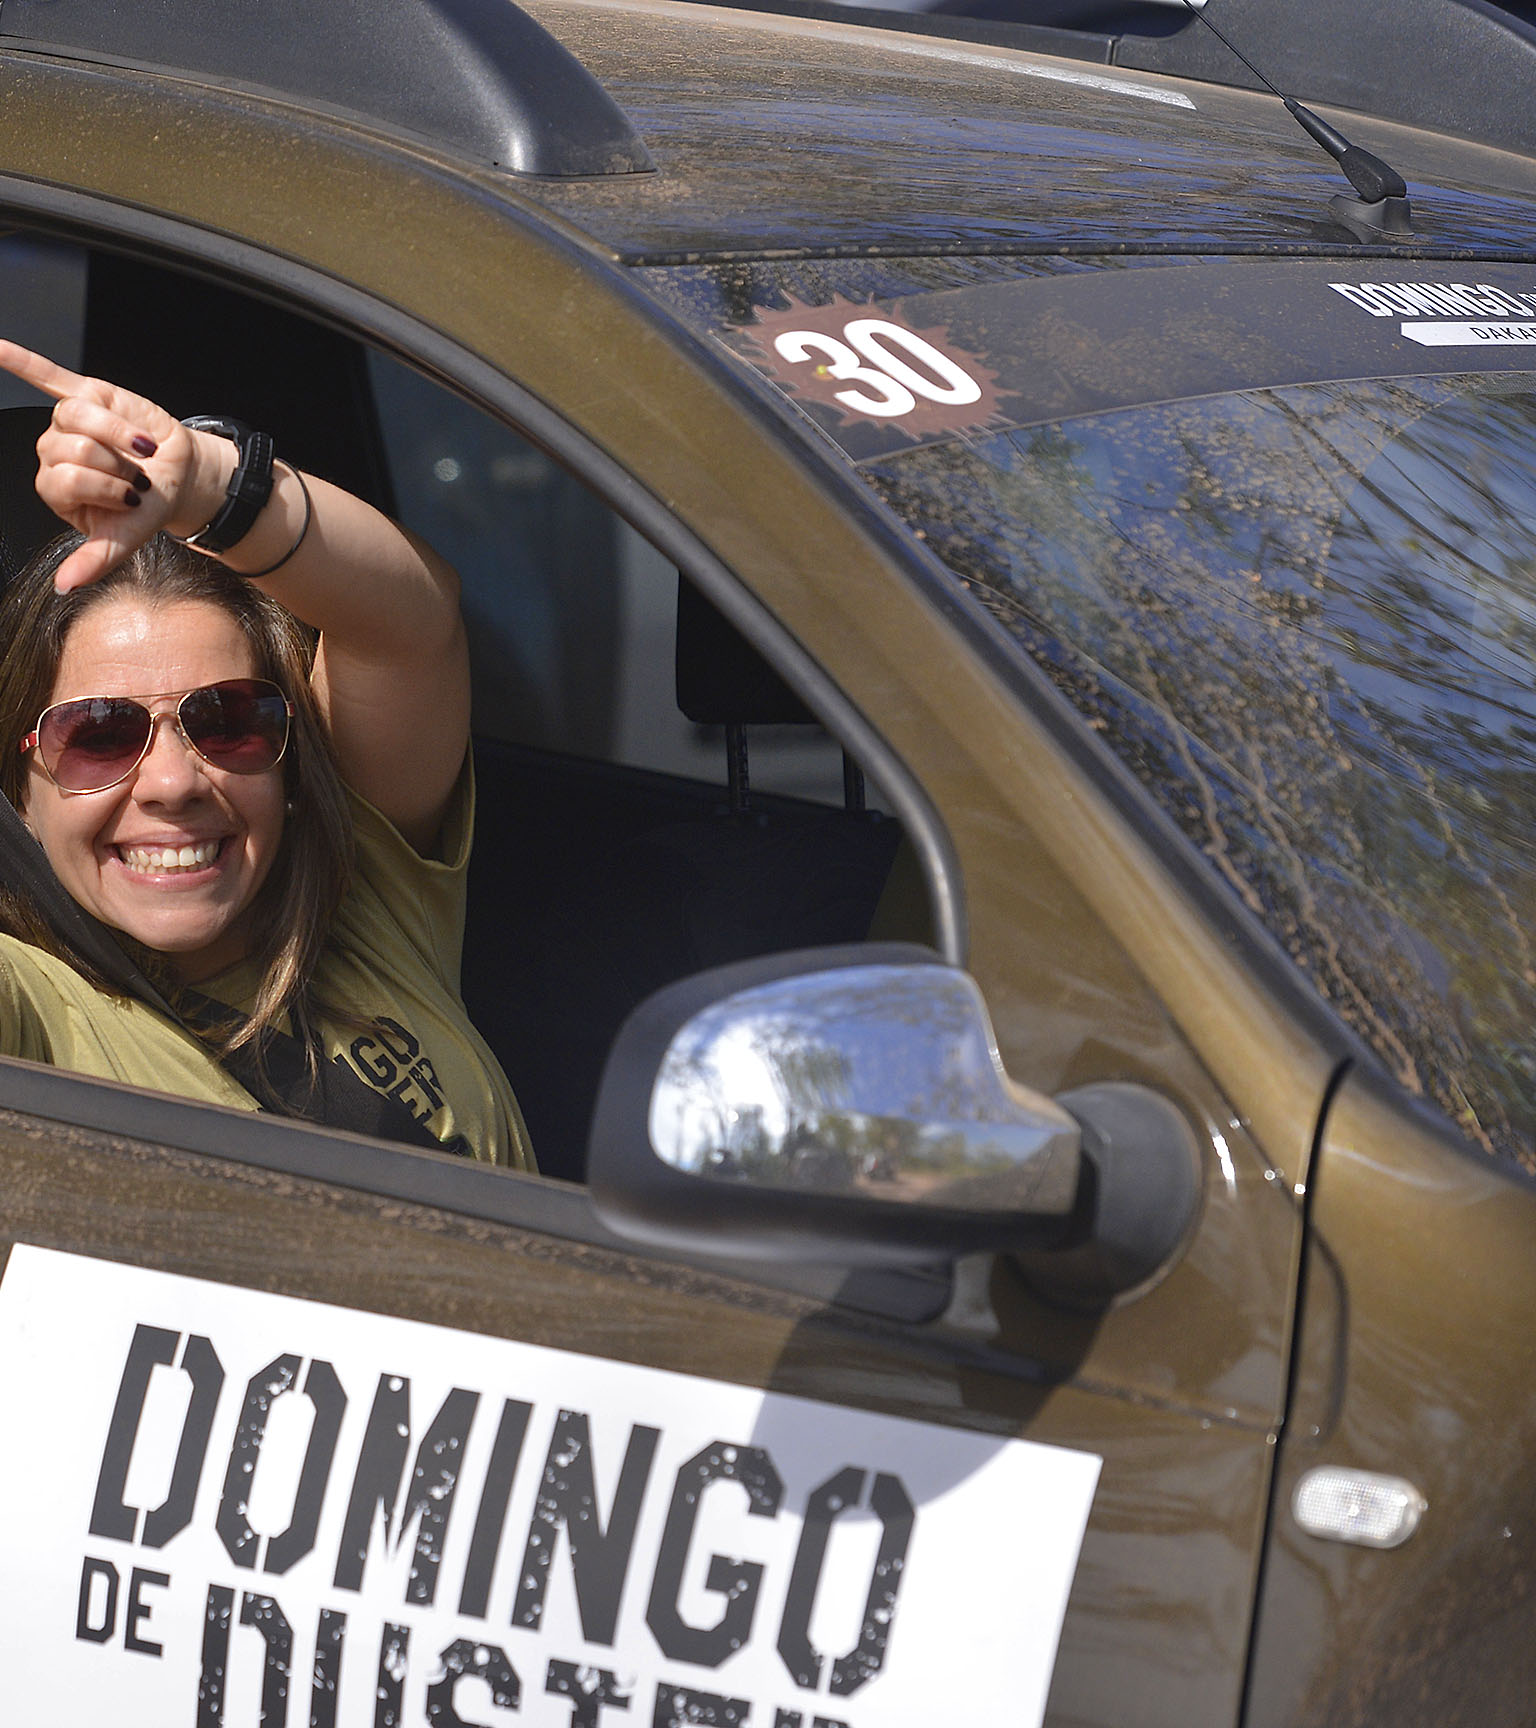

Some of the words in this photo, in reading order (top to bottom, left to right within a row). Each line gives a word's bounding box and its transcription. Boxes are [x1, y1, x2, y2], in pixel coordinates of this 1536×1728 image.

[1327, 283, 1535, 317] DOMINGO
[774, 318, 982, 418] 30
[88, 1323, 917, 1699] DOMINGO
[76, 1556, 170, 1657] DE
